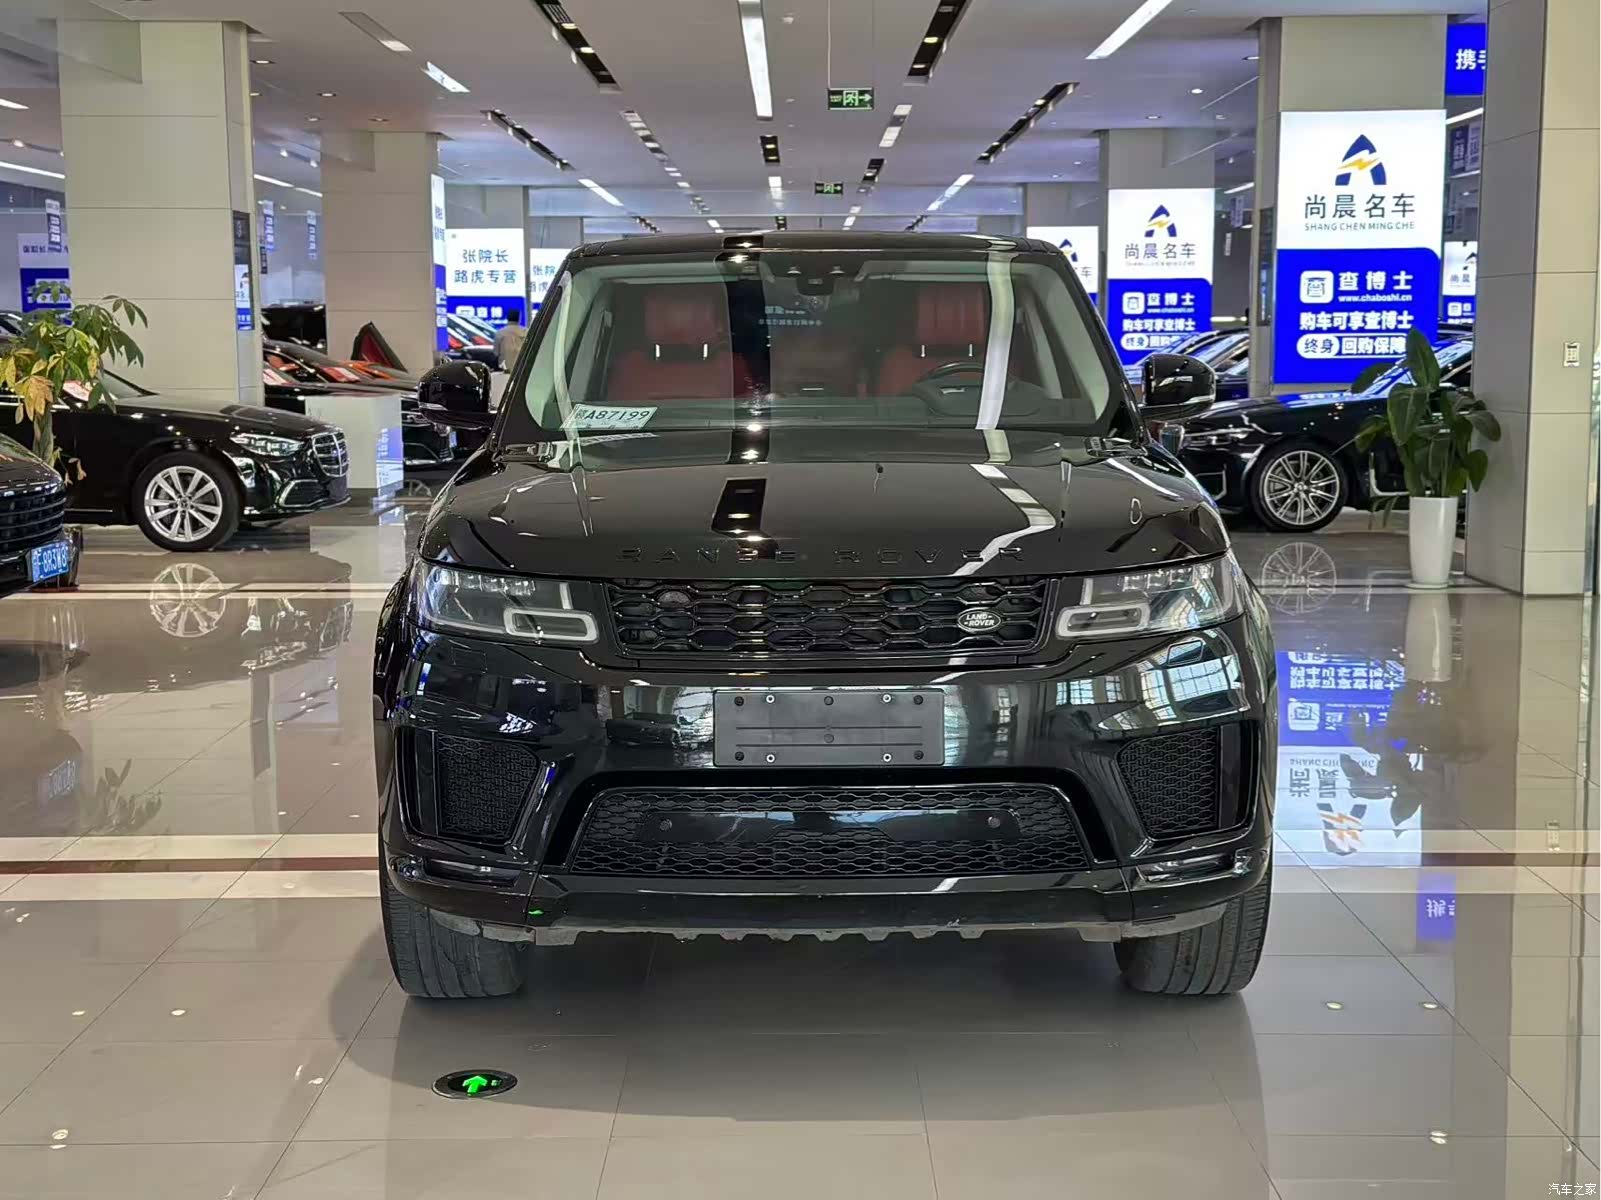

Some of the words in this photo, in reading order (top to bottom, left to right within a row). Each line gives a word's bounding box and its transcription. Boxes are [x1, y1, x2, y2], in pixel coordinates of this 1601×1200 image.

[1304, 192, 1416, 219] 尚晨名车
[1304, 222, 1338, 232] SHANG
[1339, 222, 1366, 231] CHEN
[1367, 222, 1394, 231] MING
[1395, 221, 1415, 230] CHE
[462, 249, 509, 264] 张院长
[1124, 242, 1196, 260] 尚晨名车
[454, 270, 517, 284] 路虎专营
[1338, 270, 1414, 291] 查博士
[1338, 293, 1413, 302] www.chaboshi.cn
[1299, 310, 1414, 331] 购车可享查博士
[1304, 338, 1333, 354] 终身
[1341, 337, 1406, 354] 回购保障
